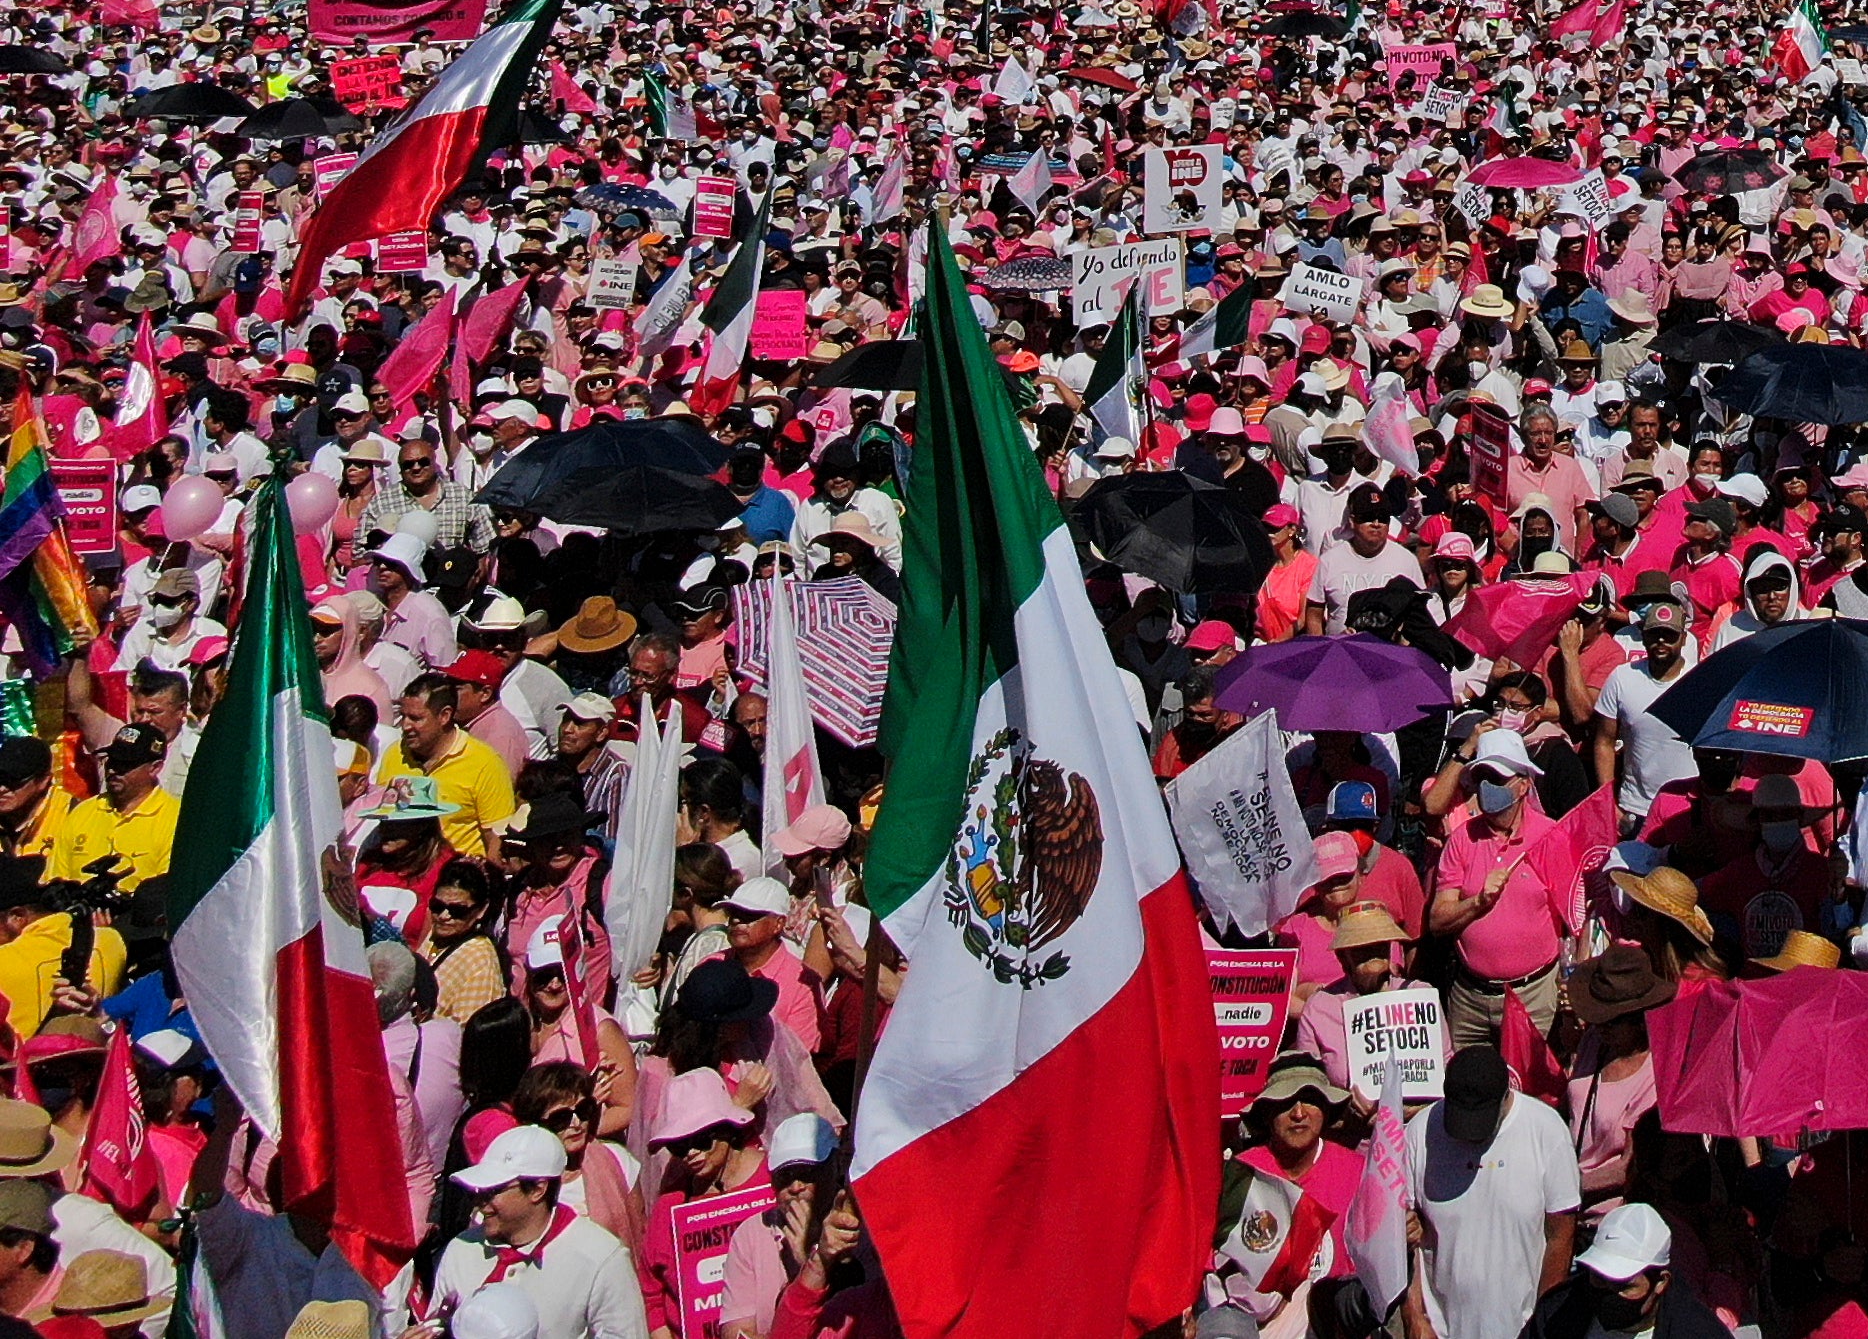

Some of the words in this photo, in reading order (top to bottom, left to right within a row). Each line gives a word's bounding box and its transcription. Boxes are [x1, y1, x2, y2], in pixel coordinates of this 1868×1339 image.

[333, 15, 400, 27] CONTAMOS
[1171, 166, 1203, 181] INE
[1573, 184, 1606, 223] SETOCA
[609, 281, 633, 291] INE
[1304, 269, 1350, 289] AMLO
[1082, 285, 1104, 314] al
[66, 506, 106, 515] VOTO
[1751, 708, 1804, 719] DEMOCRACIA
[1760, 703, 1801, 713] DEFIENDO
[1749, 715, 1790, 723] DEFIENDO
[1756, 722, 1802, 735] INE
[1210, 808, 1224, 828] NO
[1215, 800, 1262, 884] DEMOCRACIA
[1239, 828, 1251, 846] LA
[1272, 843, 1293, 872] NO
[1210, 960, 1230, 968] POR
[1230, 960, 1262, 968] ENCIMA
[1209, 971, 1288, 995] ONSTITUCIÓN
[1351, 1002, 1438, 1035] #ELINENO
[1220, 1035, 1271, 1050] VOTO
[1364, 1026, 1431, 1055] SETOCA
[1230, 1058, 1260, 1076] TOCA
[1362, 1058, 1436, 1077] #MAHAPORLA
[686, 1212, 708, 1224] POR
[708, 1204, 751, 1219] ENCIMA
[751, 1198, 766, 1209] DE
[694, 1292, 722, 1312] MI
